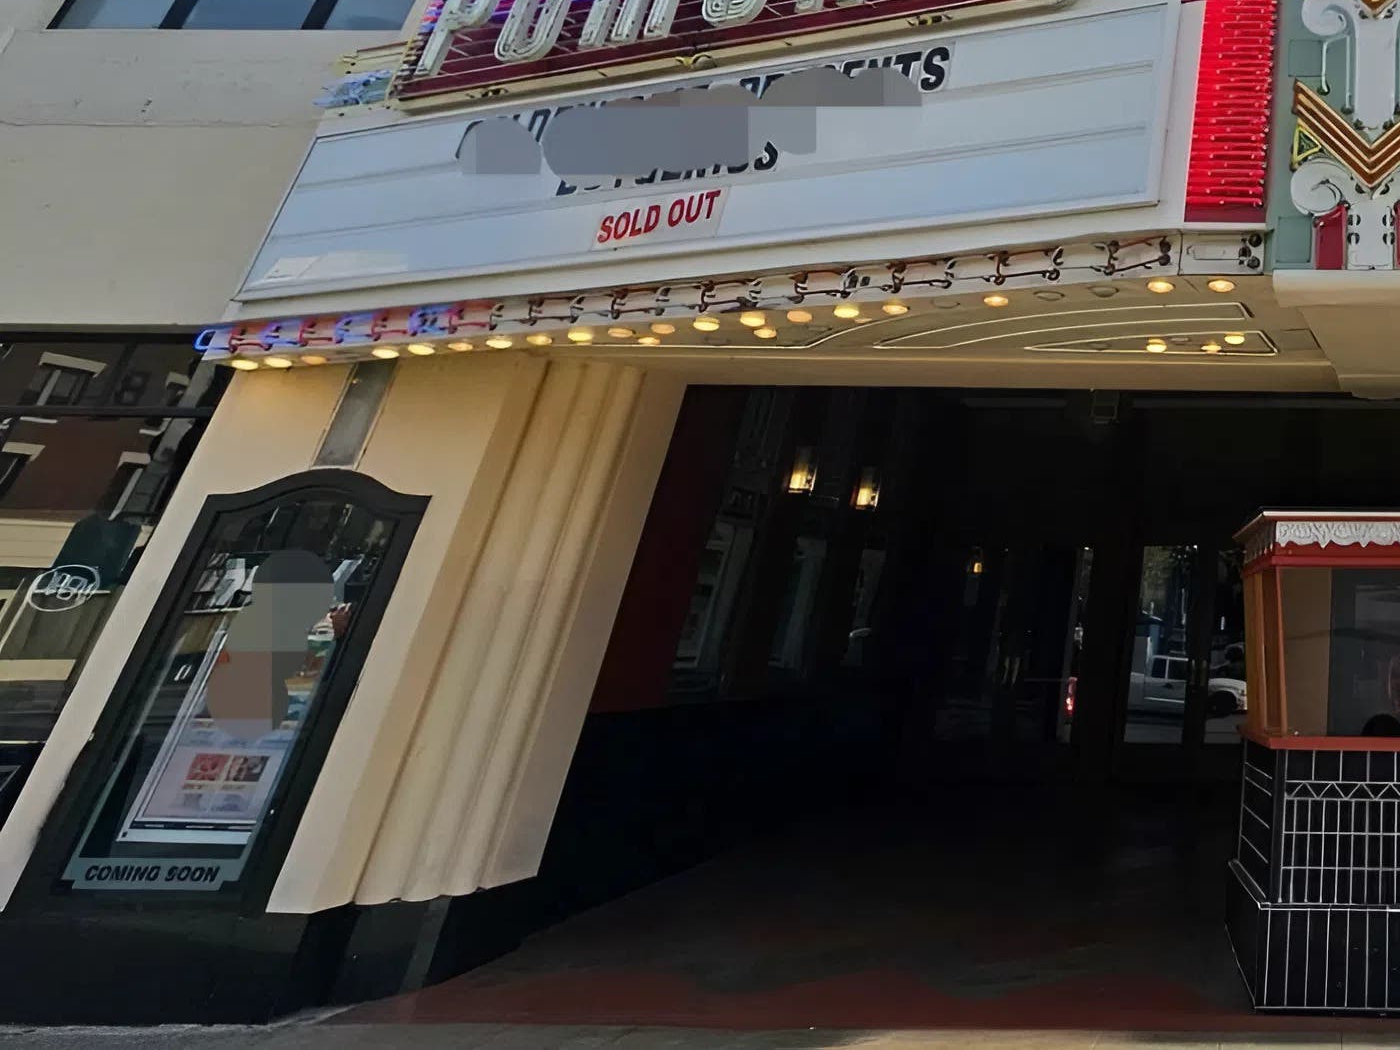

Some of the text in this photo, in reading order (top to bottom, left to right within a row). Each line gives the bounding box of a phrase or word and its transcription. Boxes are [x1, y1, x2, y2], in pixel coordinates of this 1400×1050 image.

[597, 189, 722, 244] SOLD OUT
[85, 864, 221, 883] COMING SOON
